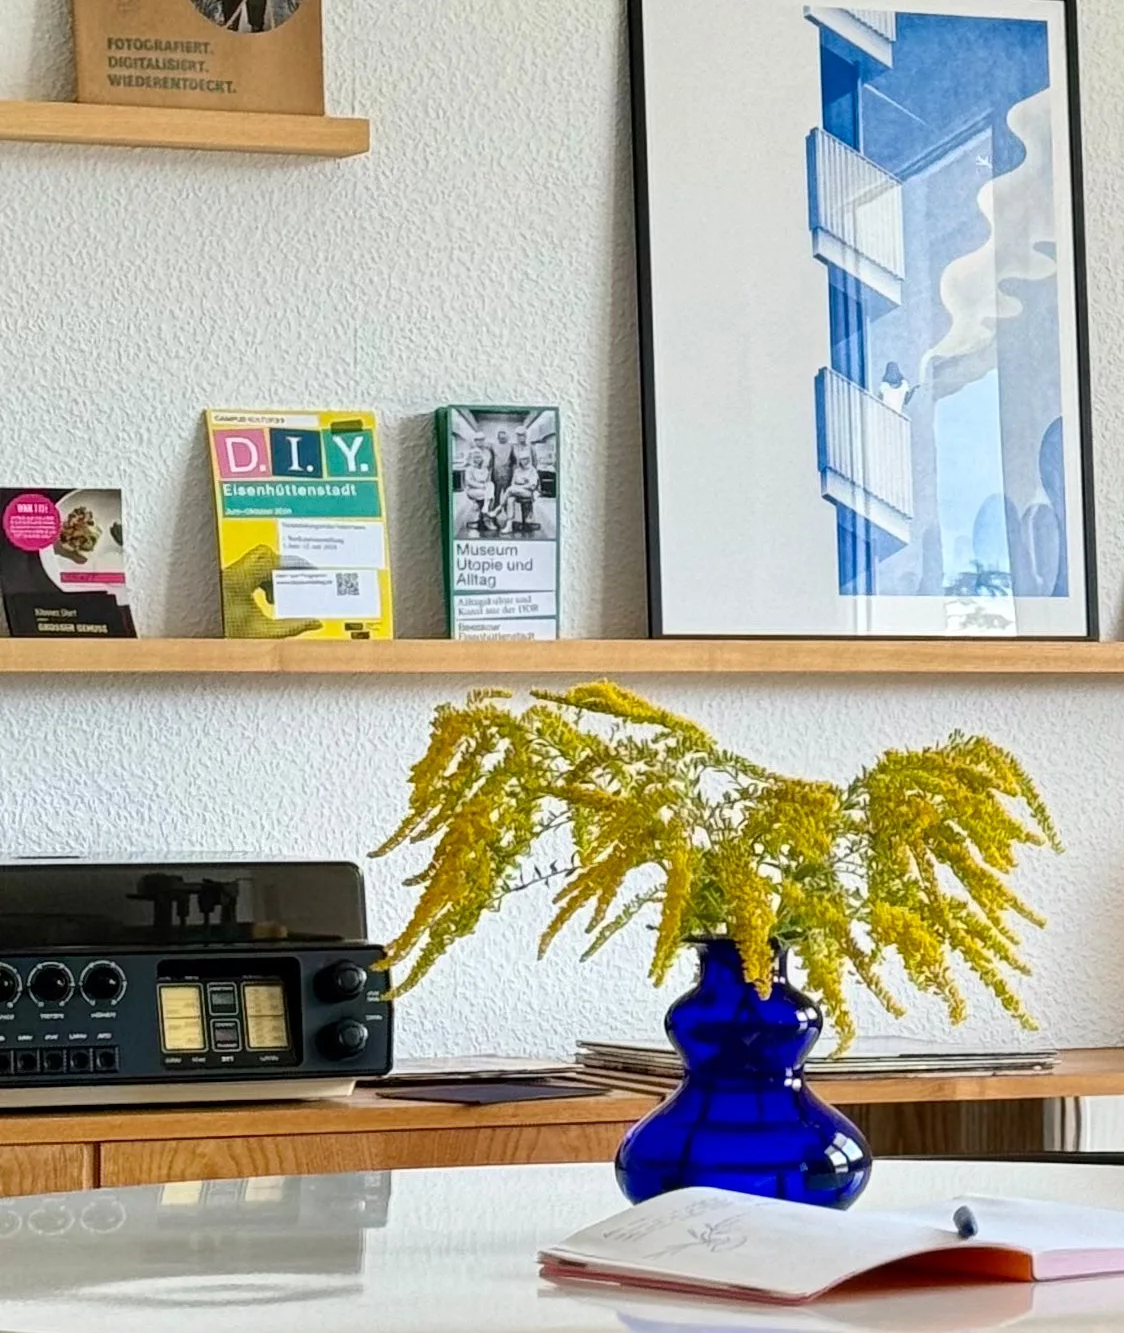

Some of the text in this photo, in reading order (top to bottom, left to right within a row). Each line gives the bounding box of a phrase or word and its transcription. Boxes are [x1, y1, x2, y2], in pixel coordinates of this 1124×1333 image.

[107, 37, 214, 55] FOTOGRAFIERT.
[107, 55, 209, 73] DIGITALISIERT.
[107, 74, 237, 94] WIEDERENTDECKT.
[223, 483, 357, 497] Eisenhüttenstadt
[456, 543, 518, 556] Museum
[457, 557, 533, 573] Utopie und
[456, 573, 497, 588] Alltag
